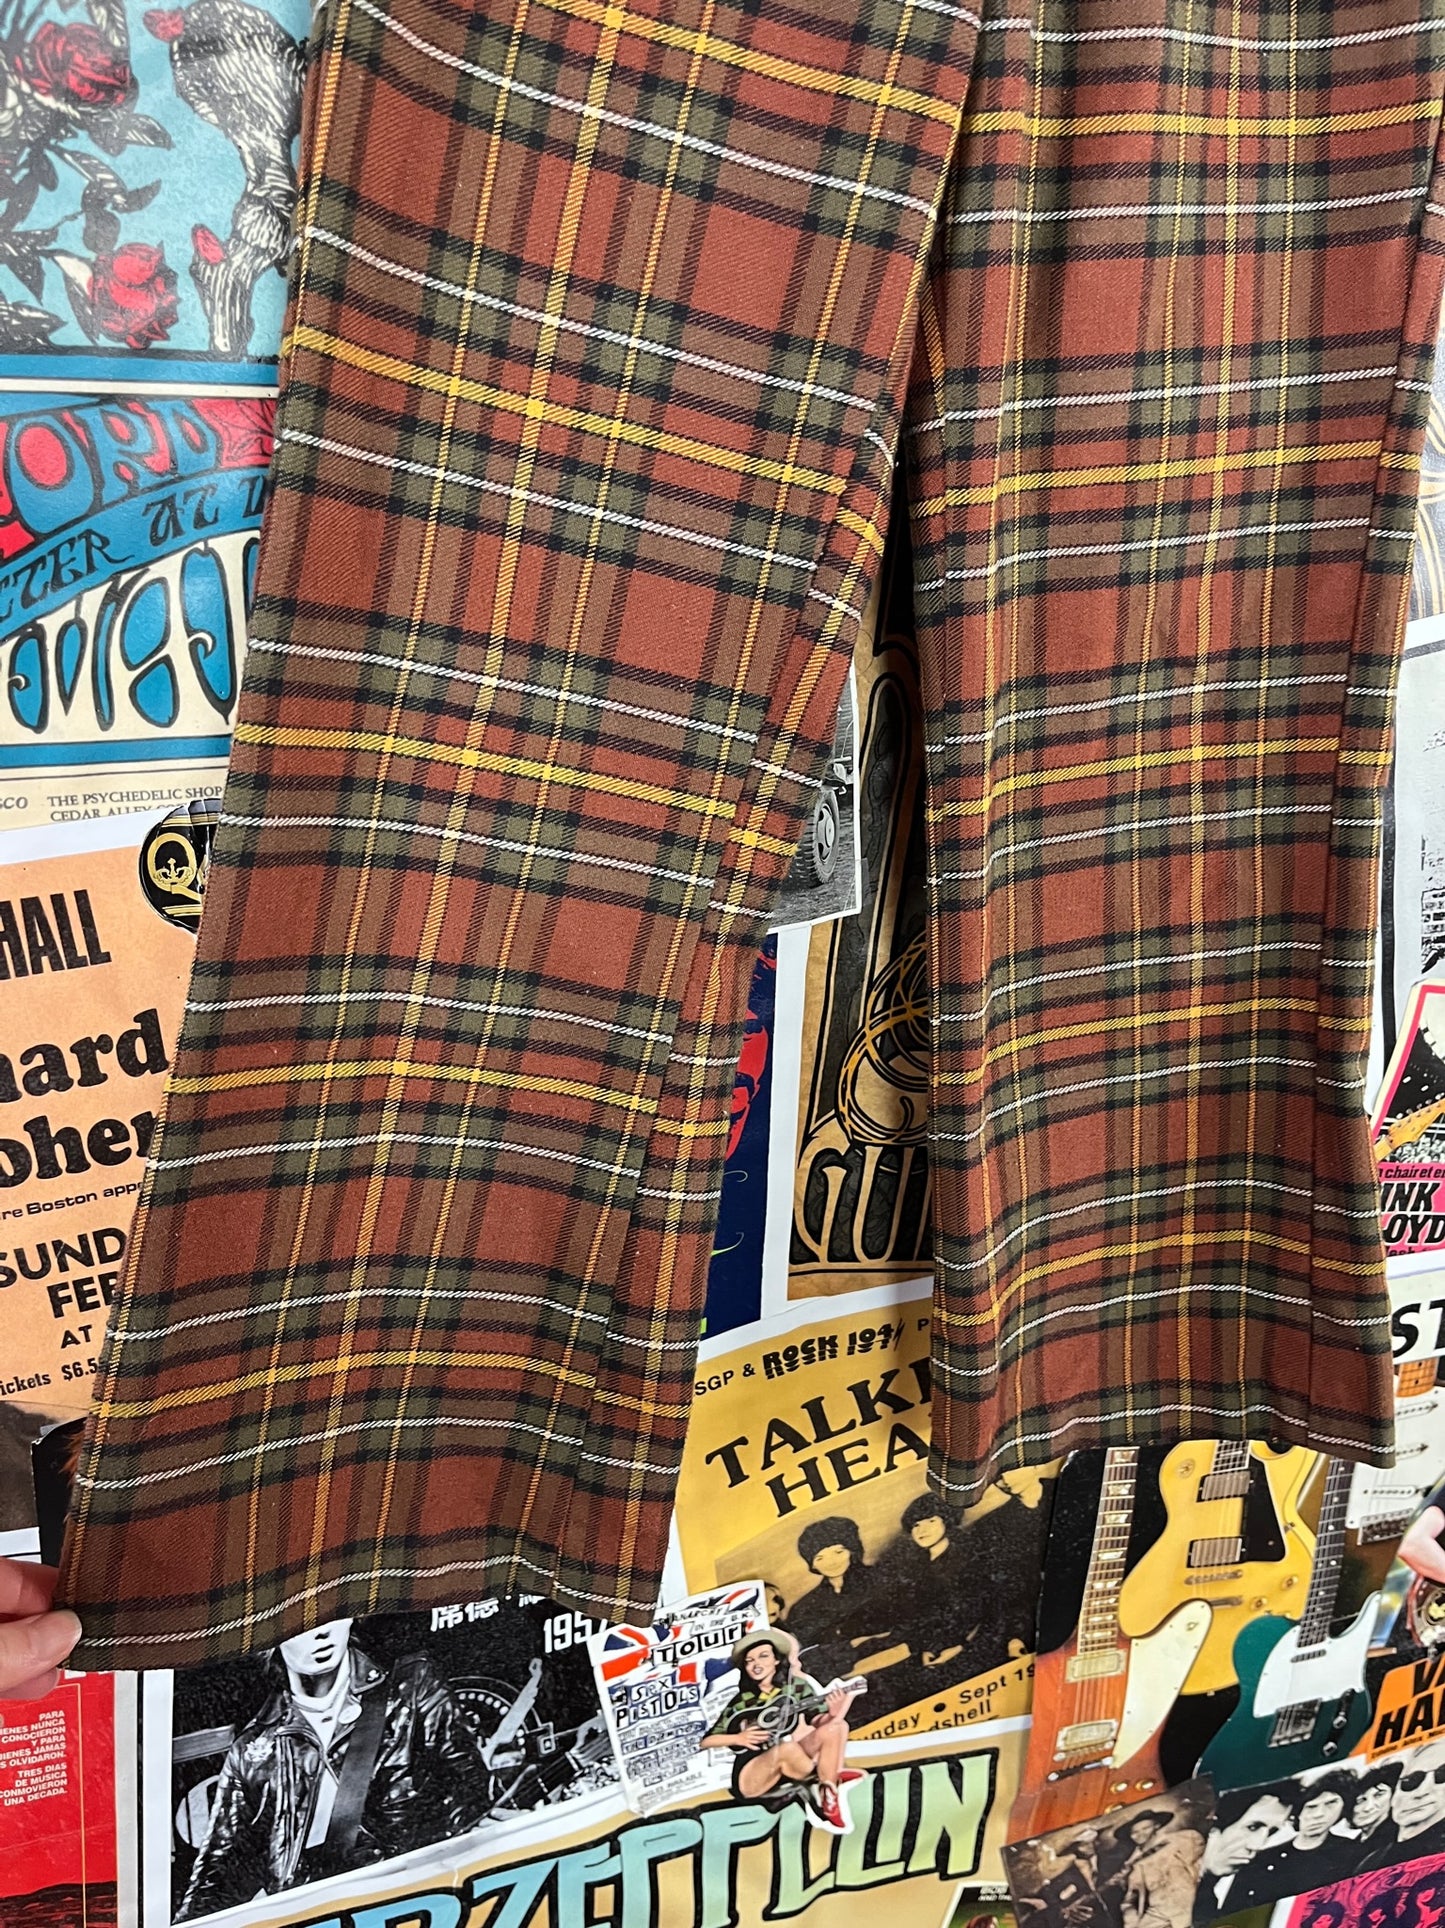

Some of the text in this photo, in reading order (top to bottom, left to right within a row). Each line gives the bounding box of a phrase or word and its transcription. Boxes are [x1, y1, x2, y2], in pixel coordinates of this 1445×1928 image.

[0, 796, 28, 809] CO
[47, 794, 78, 808] THE
[82, 788, 182, 806] PSYCHEDELIC
[185, 786, 223, 799] SHOP
[50, 809, 102, 822] CEDAR
[1384, 1165, 1419, 1179] chair
[1418, 1166, 1434, 1178] et
[0, 1207, 23, 1220] re
[26, 1192, 98, 1216] Boston
[1382, 1213, 1445, 1244] OYD
[0, 1227, 128, 1288] SUND
[60, 1324, 92, 1350] AT
[694, 1370, 735, 1396] SGP
[742, 1363, 756, 1378] &
[762, 1334, 838, 1380] ROCK
[765, 1422, 930, 1518] HEA
[39, 1709, 66, 1721] PARA
[863, 1712, 921, 1740] nday
[959, 1675, 1008, 1705] Sept
[920, 1699, 991, 1732] dshell
[30, 1717, 66, 1732] NUNCA
[1, 1725, 66, 1744] CONOCIERON
[31, 1733, 66, 1747] Y PARA
[33, 1741, 67, 1755] JAMAS
[18, 1761, 67, 1778] TRES DIAS
[15, 1770, 67, 1788] DE MUSICA
[4, 1795, 26, 1806] UNA
